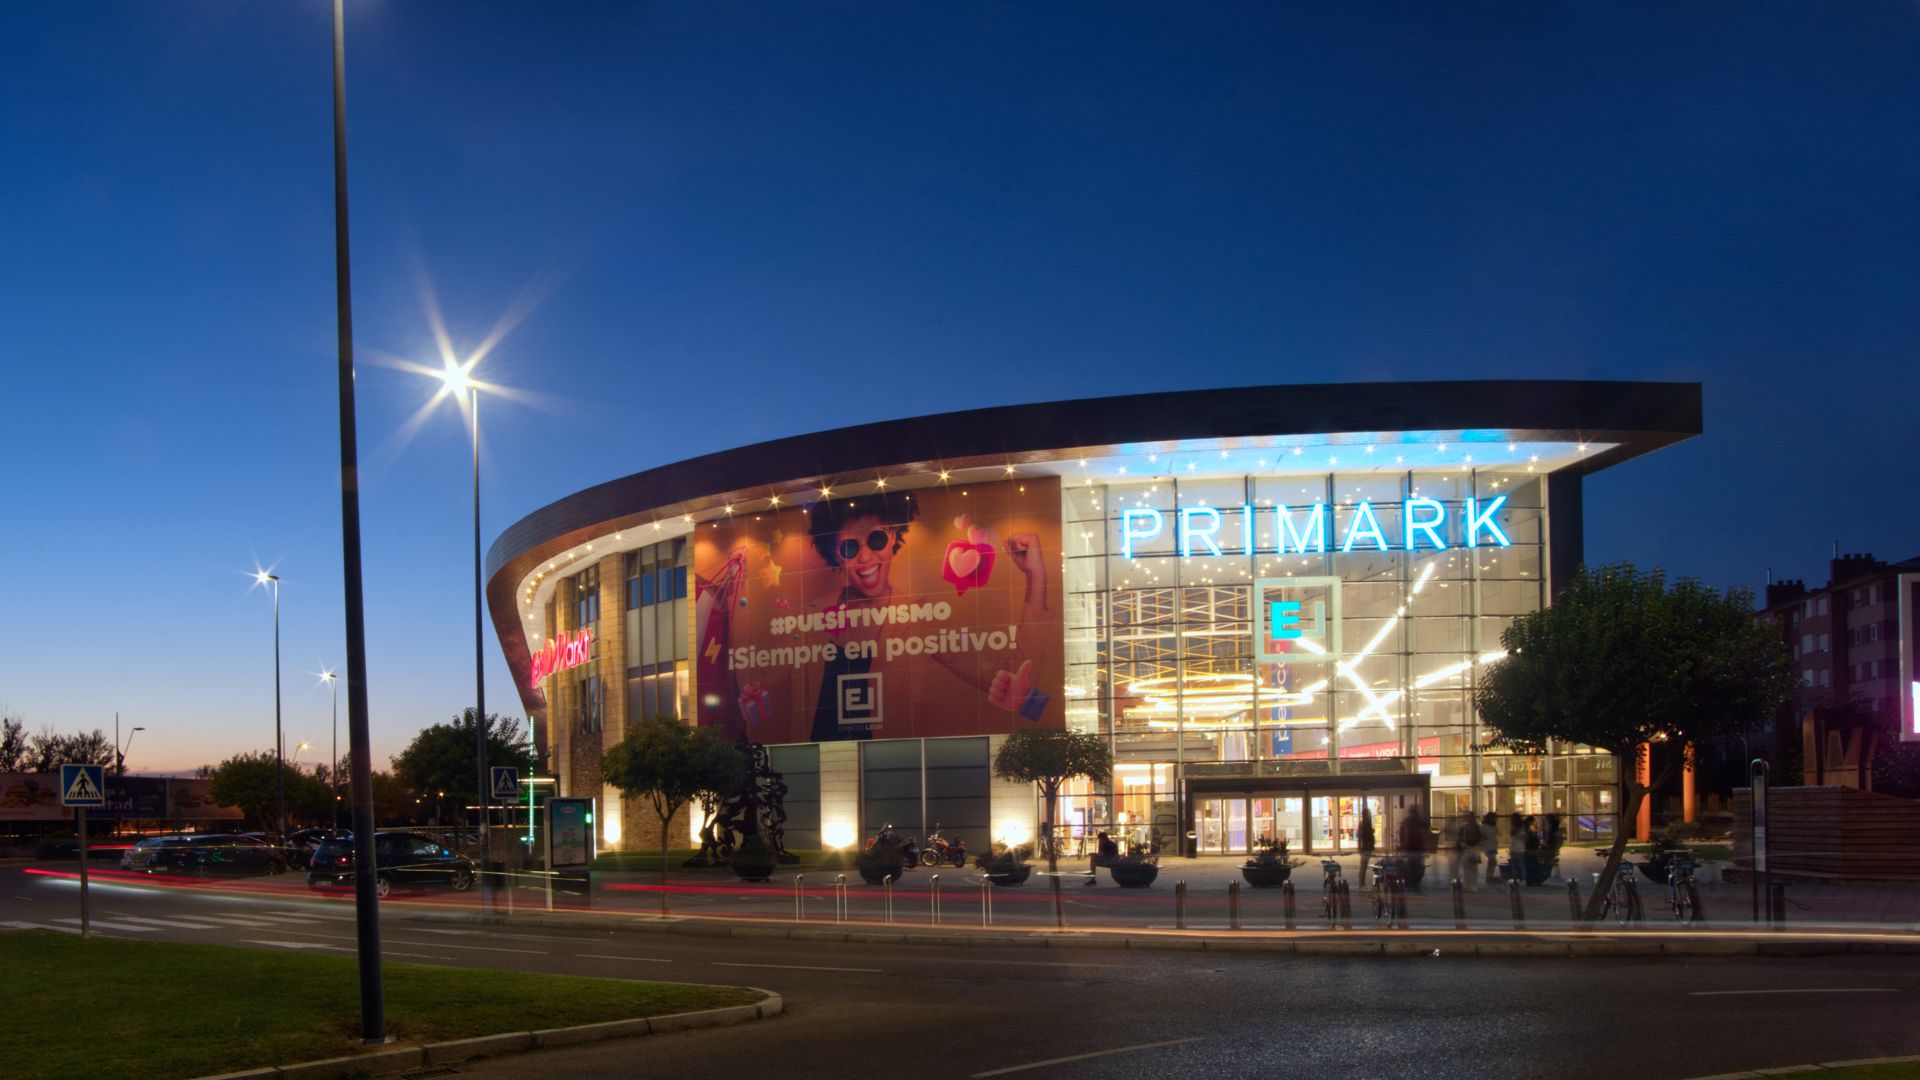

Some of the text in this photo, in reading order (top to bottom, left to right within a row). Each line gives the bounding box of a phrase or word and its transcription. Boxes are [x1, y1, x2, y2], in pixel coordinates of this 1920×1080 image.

[1121, 495, 1512, 560] PRIMARK
[728, 625, 1018, 671] ¡Siempre en positivo!
